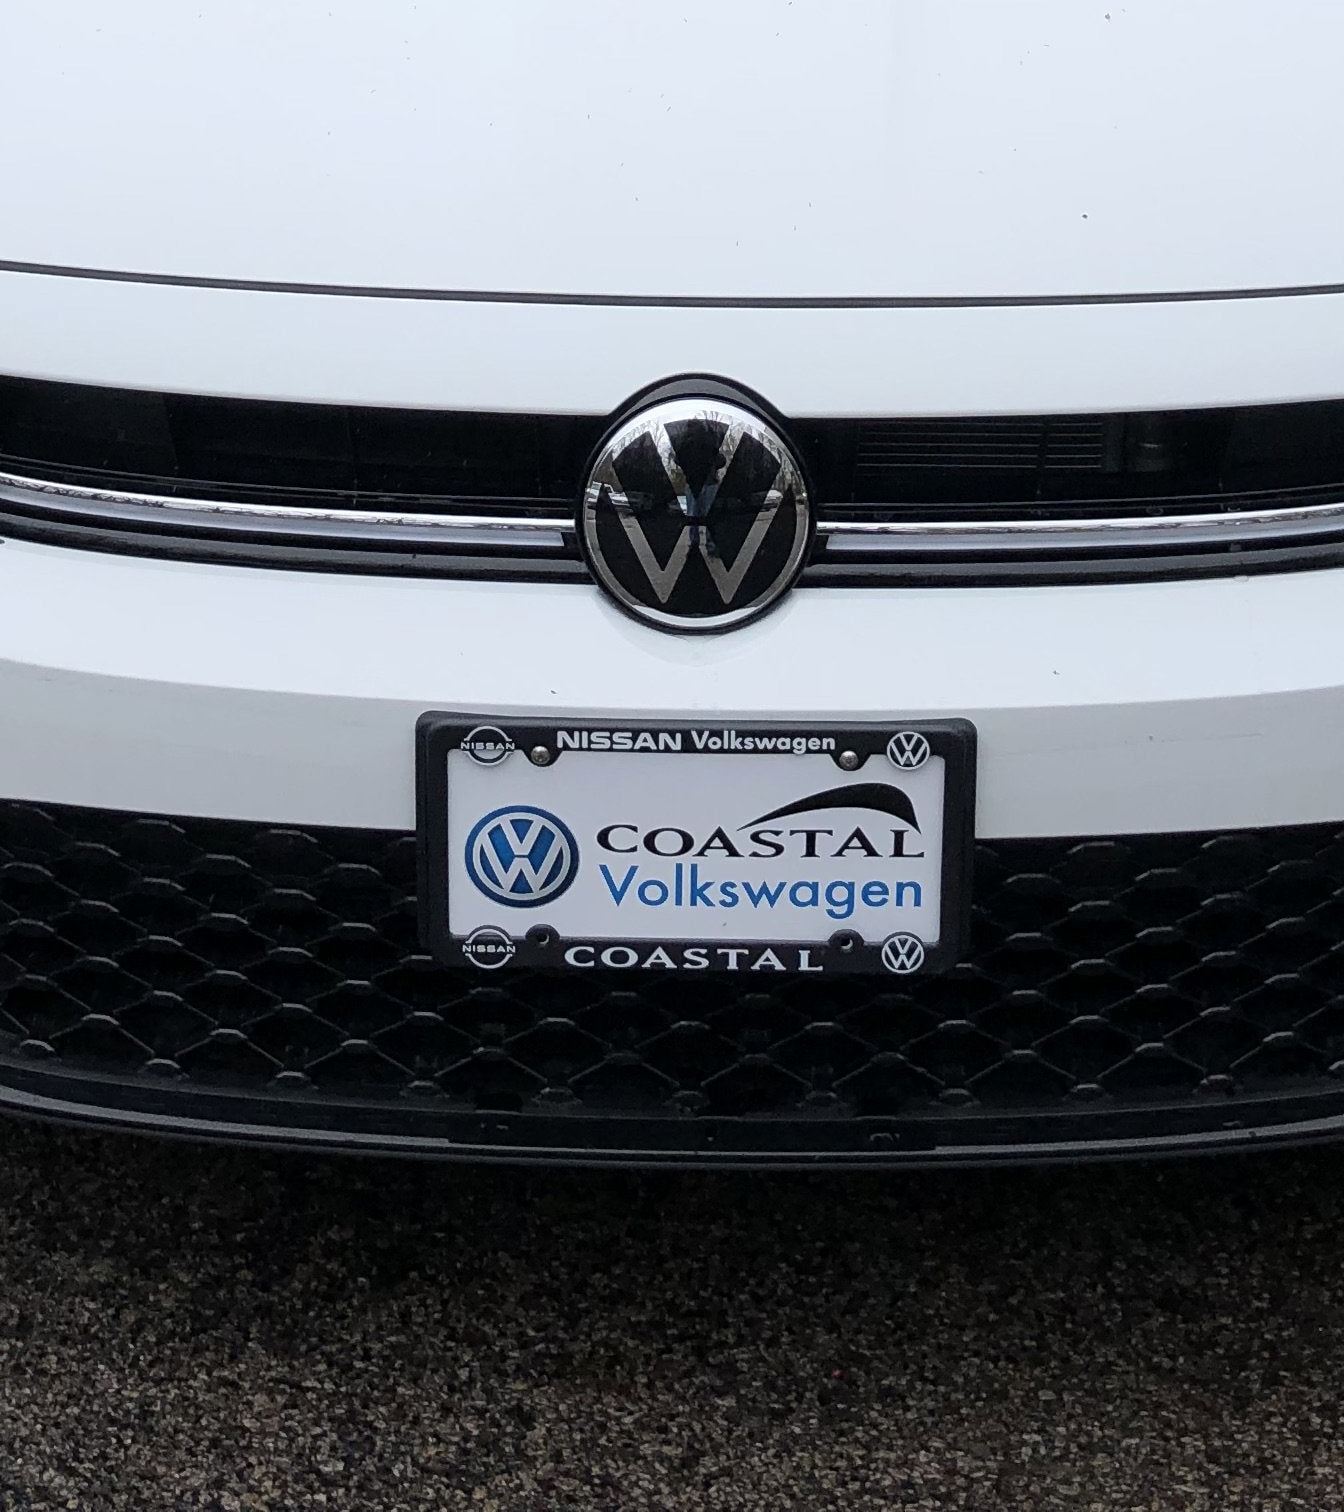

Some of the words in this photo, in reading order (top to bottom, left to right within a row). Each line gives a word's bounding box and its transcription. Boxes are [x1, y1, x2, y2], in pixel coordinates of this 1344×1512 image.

[460, 741, 516, 750] NISSAN
[556, 730, 682, 751] NISSAN
[690, 729, 836, 755] Volkswagen
[596, 824, 925, 858] COASTAL
[598, 863, 922, 920] Volkswagen
[462, 944, 516, 954] NISSAN
[564, 945, 824, 971] COASTAL
